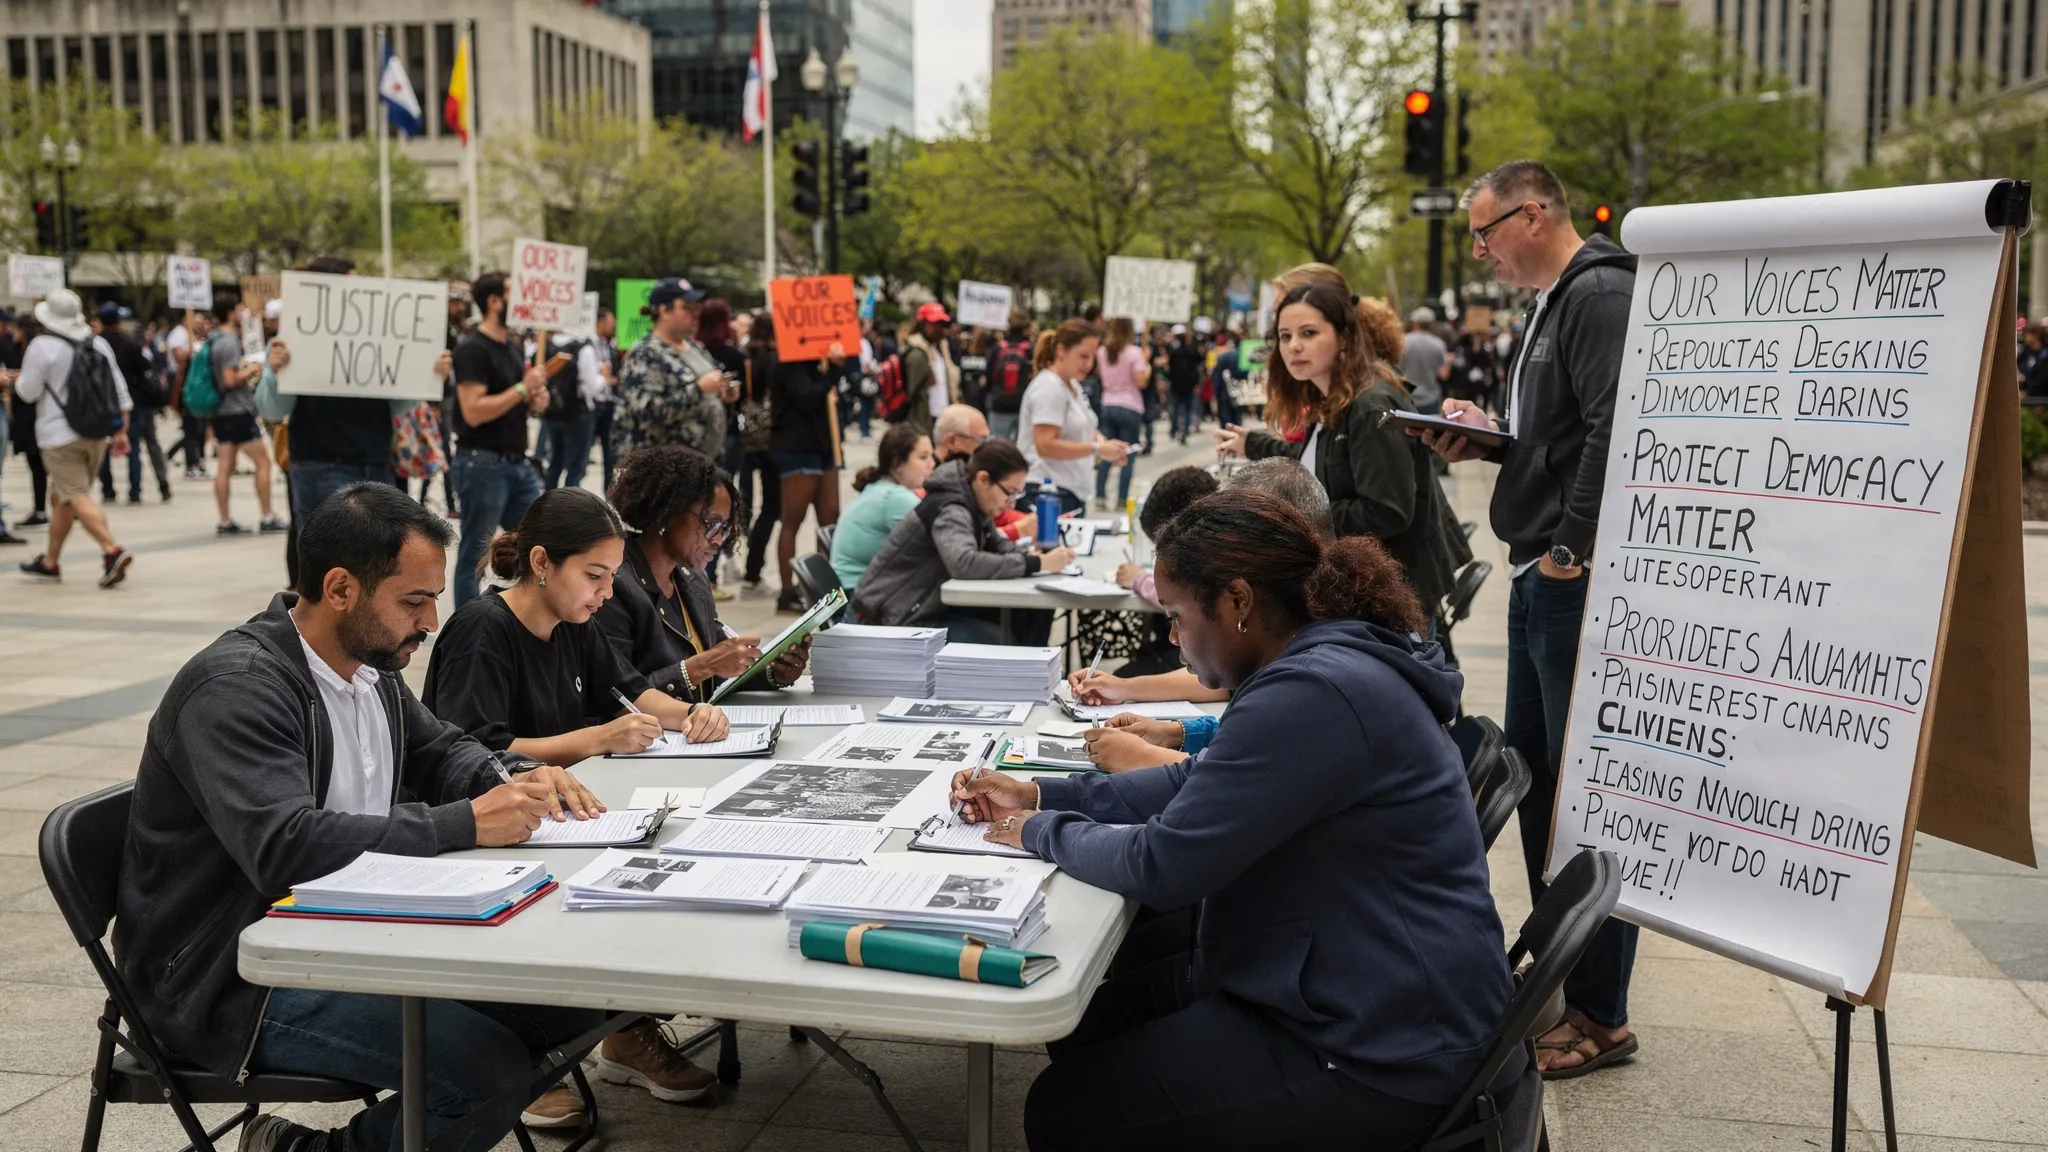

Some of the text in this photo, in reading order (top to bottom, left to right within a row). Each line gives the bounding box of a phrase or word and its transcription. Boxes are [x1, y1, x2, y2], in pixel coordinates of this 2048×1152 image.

[522, 243, 559, 271] OUR
[518, 273, 577, 305] VOICES
[791, 280, 832, 302] OUR
[1649, 252, 1946, 321] OUR VOICES MATTER
[296, 281, 437, 344] JUSTICE
[329, 339, 405, 387] NOW
[1793, 324, 1929, 370] DEGKING
[1797, 379, 1910, 419] BARINS
[1631, 428, 1751, 487] PROTECT
[1627, 493, 1756, 554] MATTER
[1604, 596, 1760, 674] PRORIDEFS
[1583, 791, 1670, 853] PHOME
[1779, 858, 1851, 902] HADT
[1811, 809, 1892, 856] DRING
